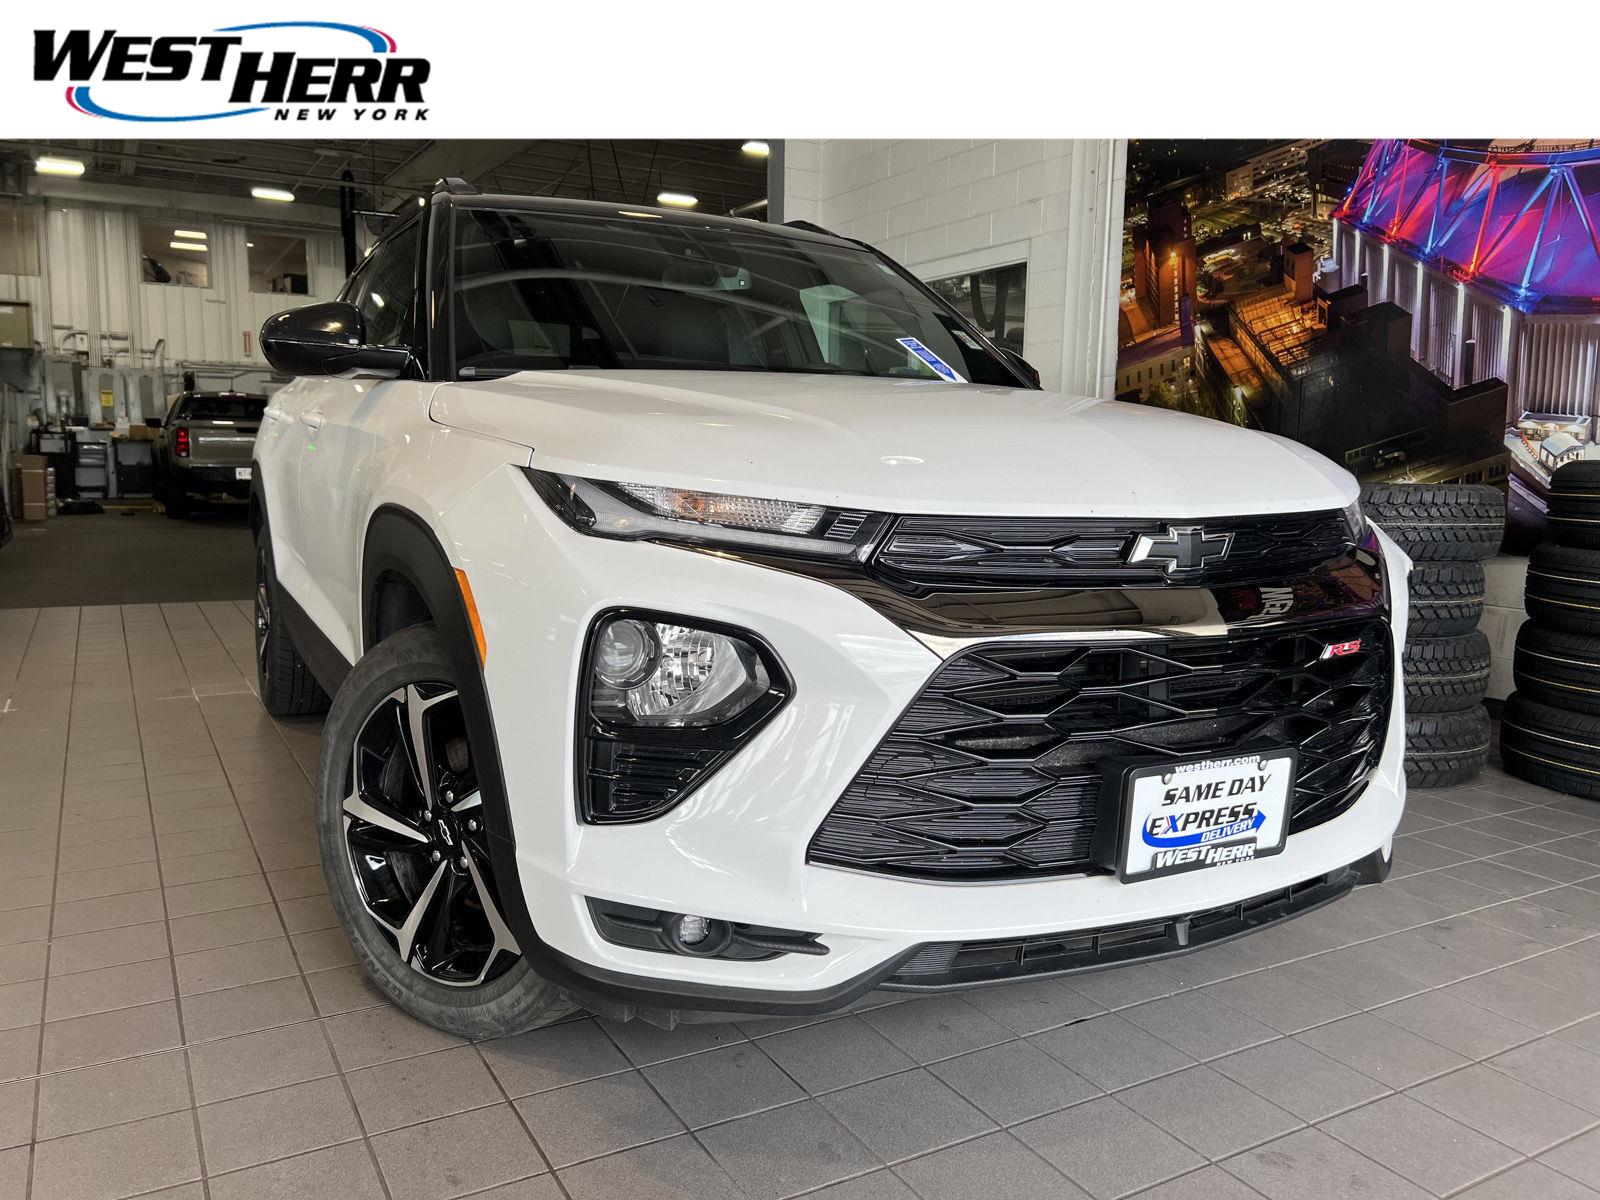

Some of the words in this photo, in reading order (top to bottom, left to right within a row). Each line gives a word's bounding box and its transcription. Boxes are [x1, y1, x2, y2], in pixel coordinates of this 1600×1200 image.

[1324, 639, 1361, 658] RS
[1174, 755, 1260, 774] westherr.com
[1161, 780, 1226, 807] SAME
[1226, 774, 1272, 798] DAY
[1149, 802, 1258, 836] EXPRESS
[1201, 818, 1256, 842] DELIVERY
